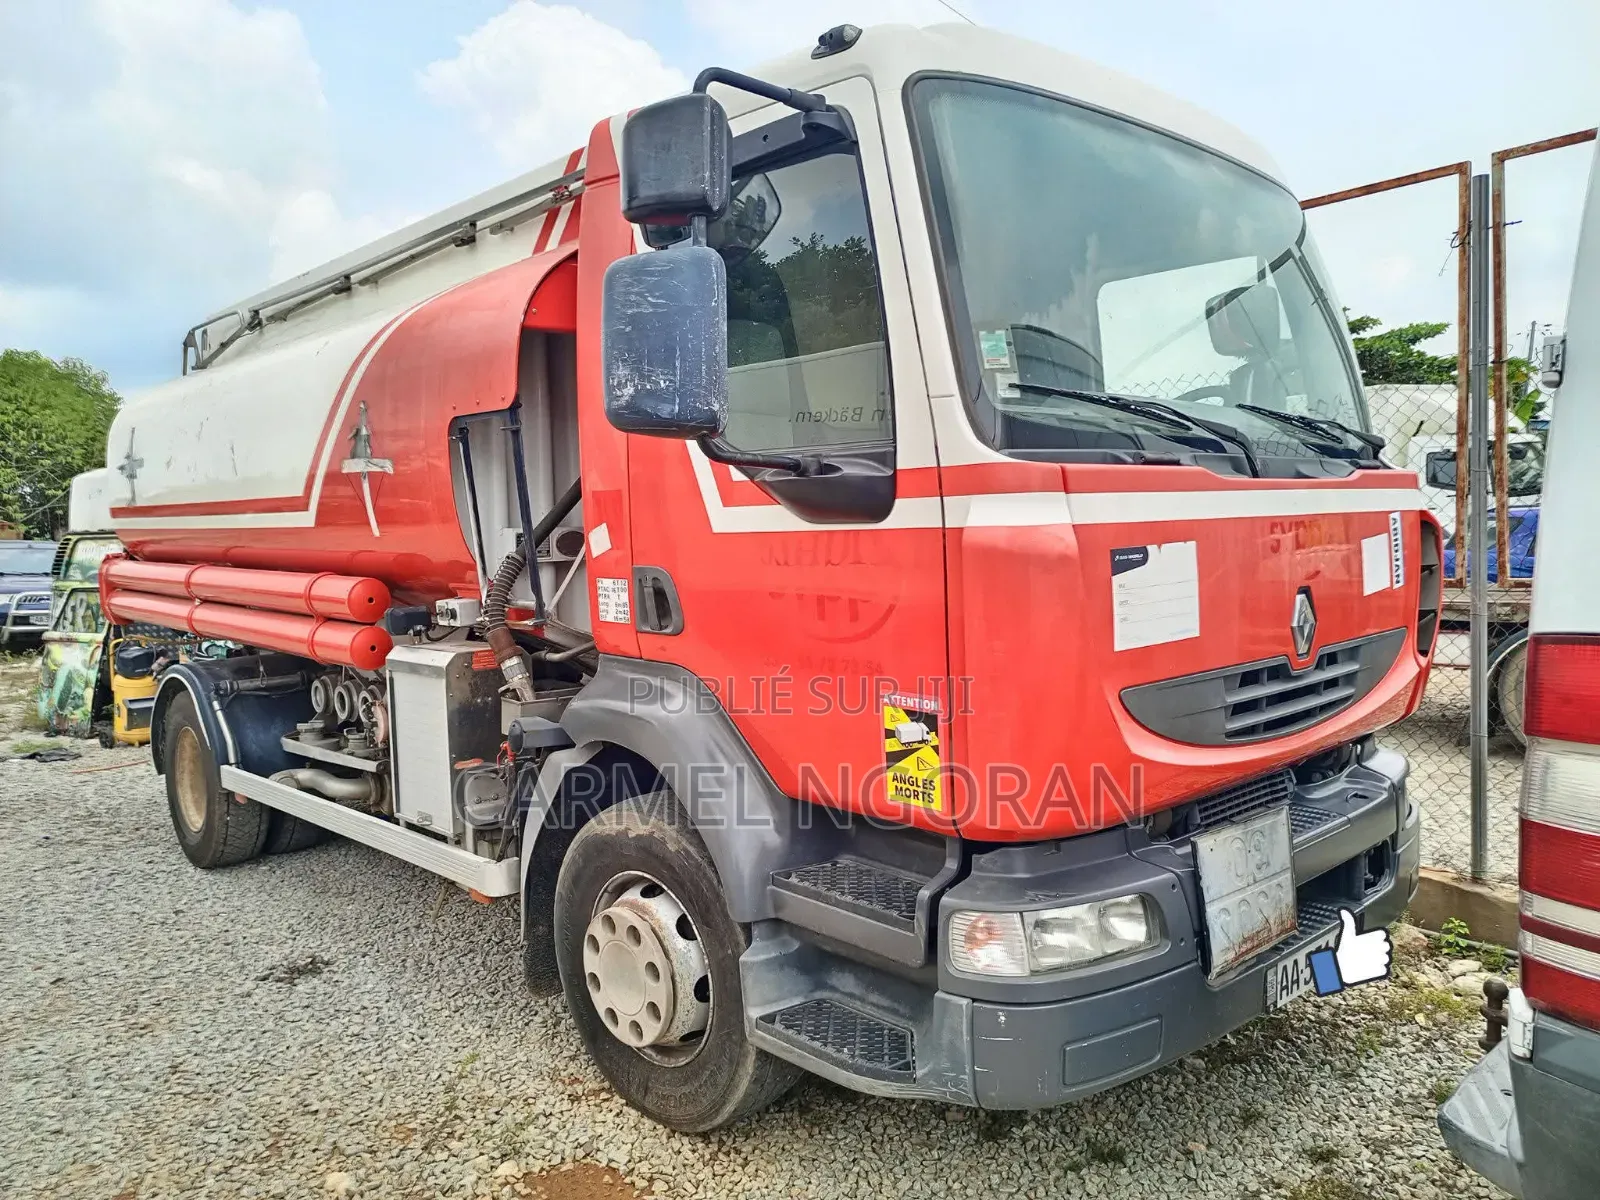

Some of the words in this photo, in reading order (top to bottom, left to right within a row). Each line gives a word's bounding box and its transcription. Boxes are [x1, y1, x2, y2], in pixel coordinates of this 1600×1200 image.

[883, 693, 939, 711] ATTENTION
[891, 771, 937, 792] ANGLES
[894, 785, 935, 804] MORTS
